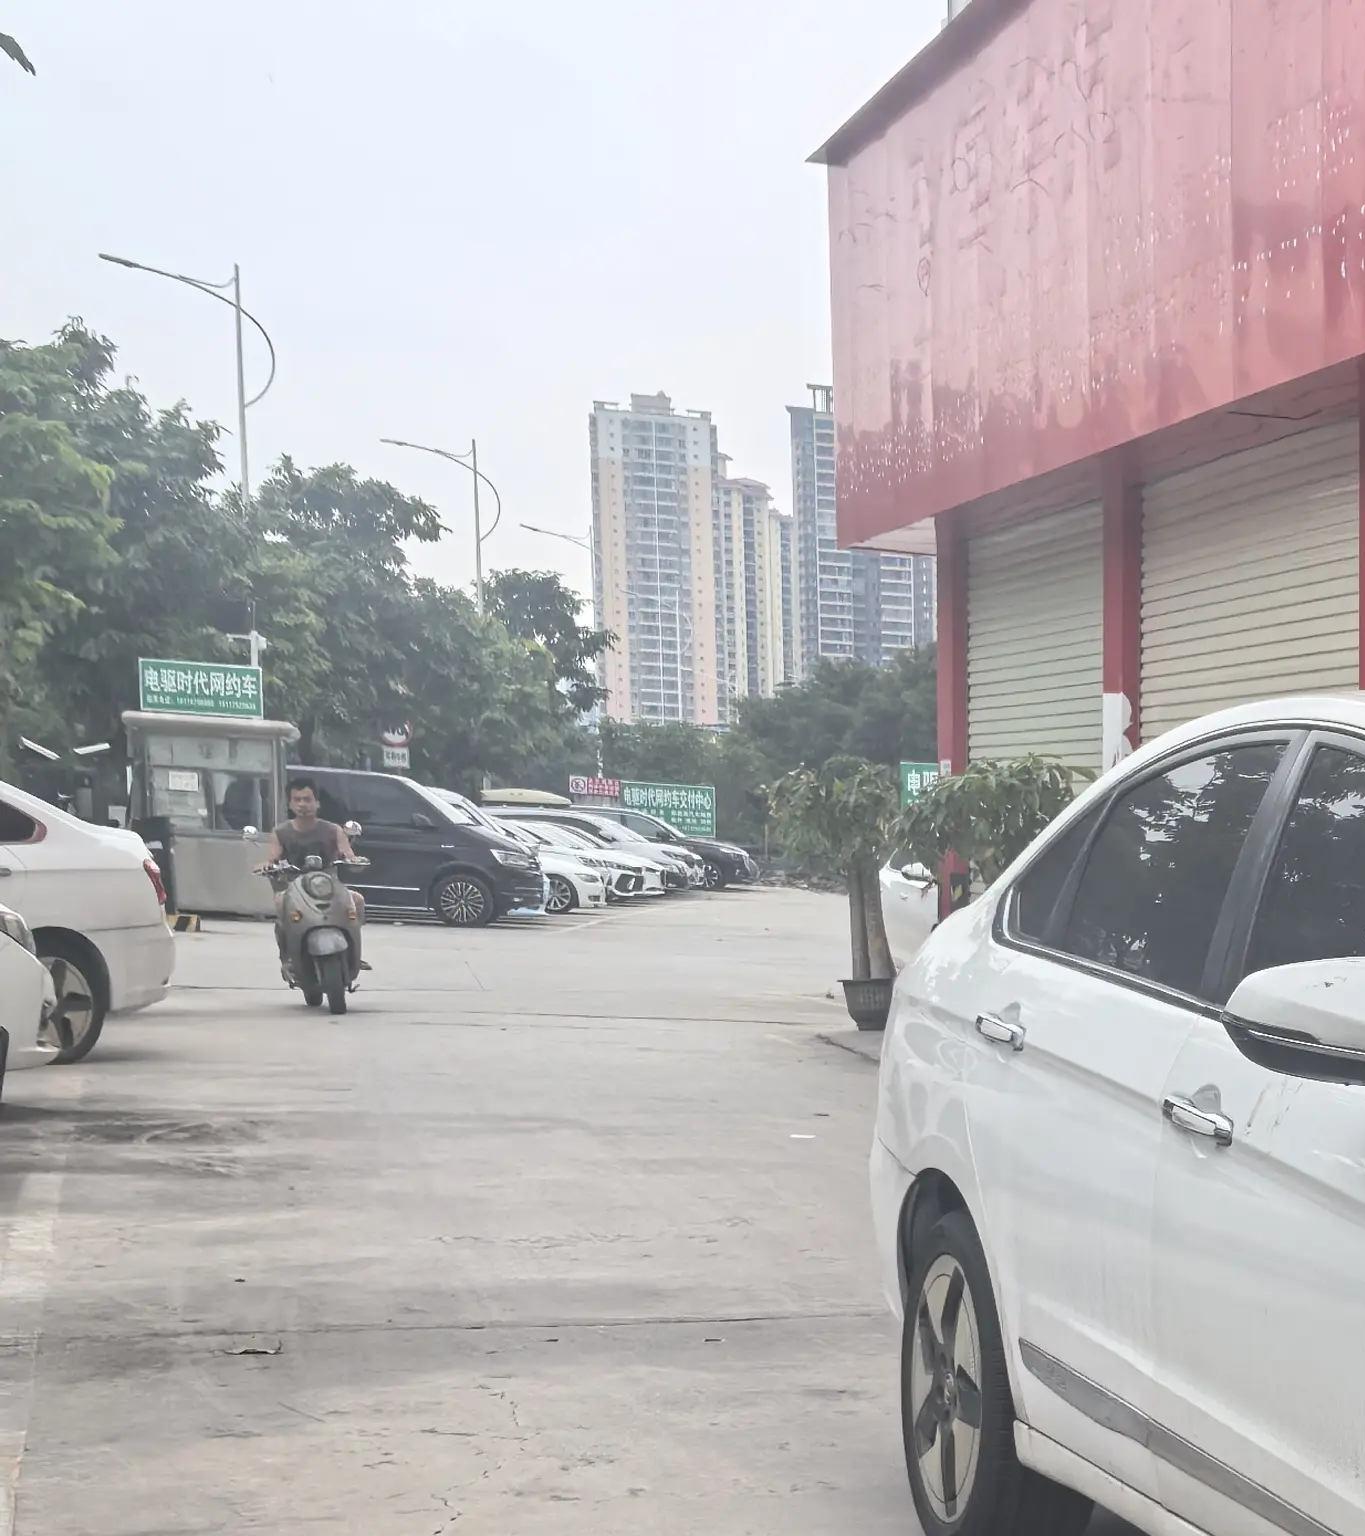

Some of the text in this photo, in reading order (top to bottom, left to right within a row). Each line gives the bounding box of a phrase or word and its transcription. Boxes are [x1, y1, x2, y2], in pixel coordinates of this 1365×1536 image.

[143, 665, 259, 699] 电驱时代网约车
[623, 786, 712, 810] 电驱时代网约车交付中心
